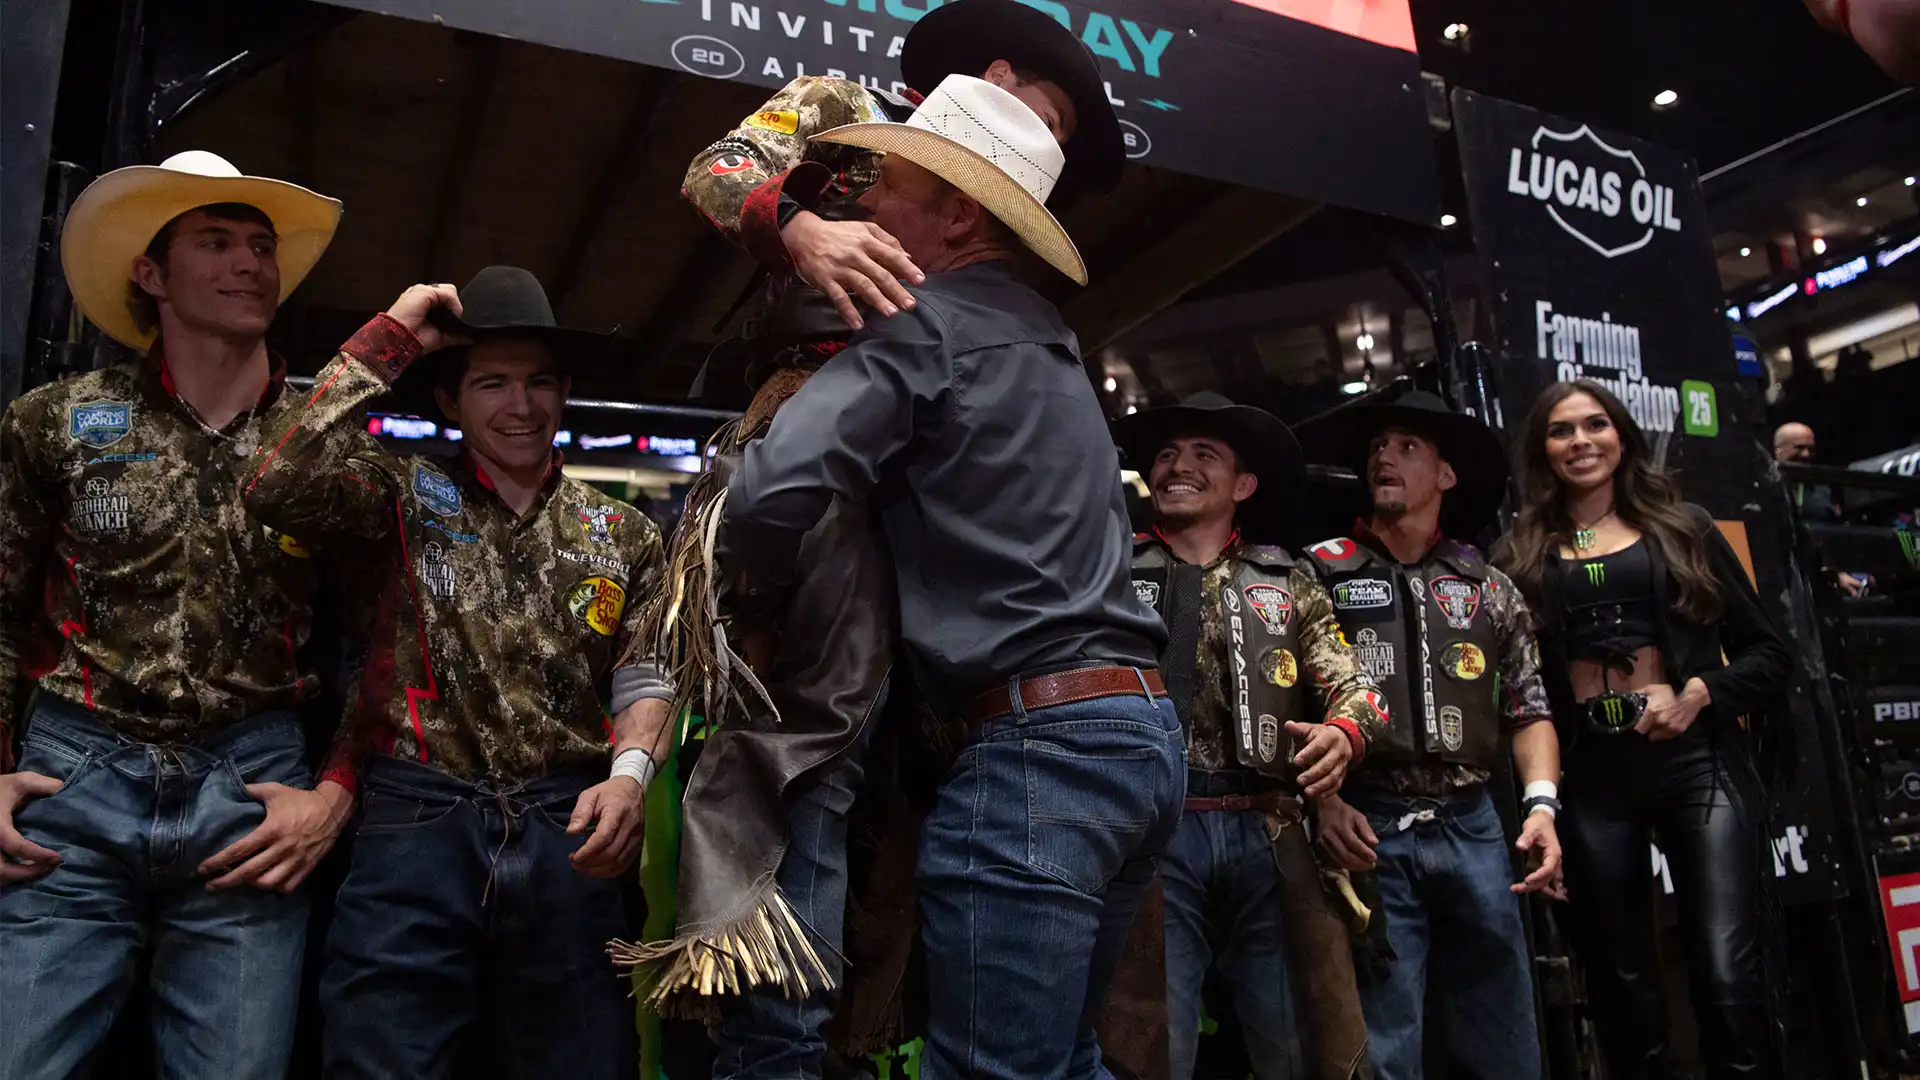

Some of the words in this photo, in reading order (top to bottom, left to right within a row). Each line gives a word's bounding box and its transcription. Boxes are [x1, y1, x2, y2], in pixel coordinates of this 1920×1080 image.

[691, 47, 725, 66] 20
[1508, 148, 1622, 218] LUCAS
[1630, 179, 1682, 231] OIL
[1535, 300, 1643, 381] Farming
[1557, 360, 1681, 433] lator
[1689, 390, 1713, 427] 25
[76, 410, 125, 421] CAMPING
[77, 416, 125, 429] WORLD
[72, 496, 129, 515] REDHEAD
[556, 548, 630, 573] TRUEVELO
[598, 579, 621, 602] Bass
[1349, 587, 1384, 595] TEAM
[596, 594, 615, 613] Pro
[1230, 616, 1253, 751] EZ-ACCESS
